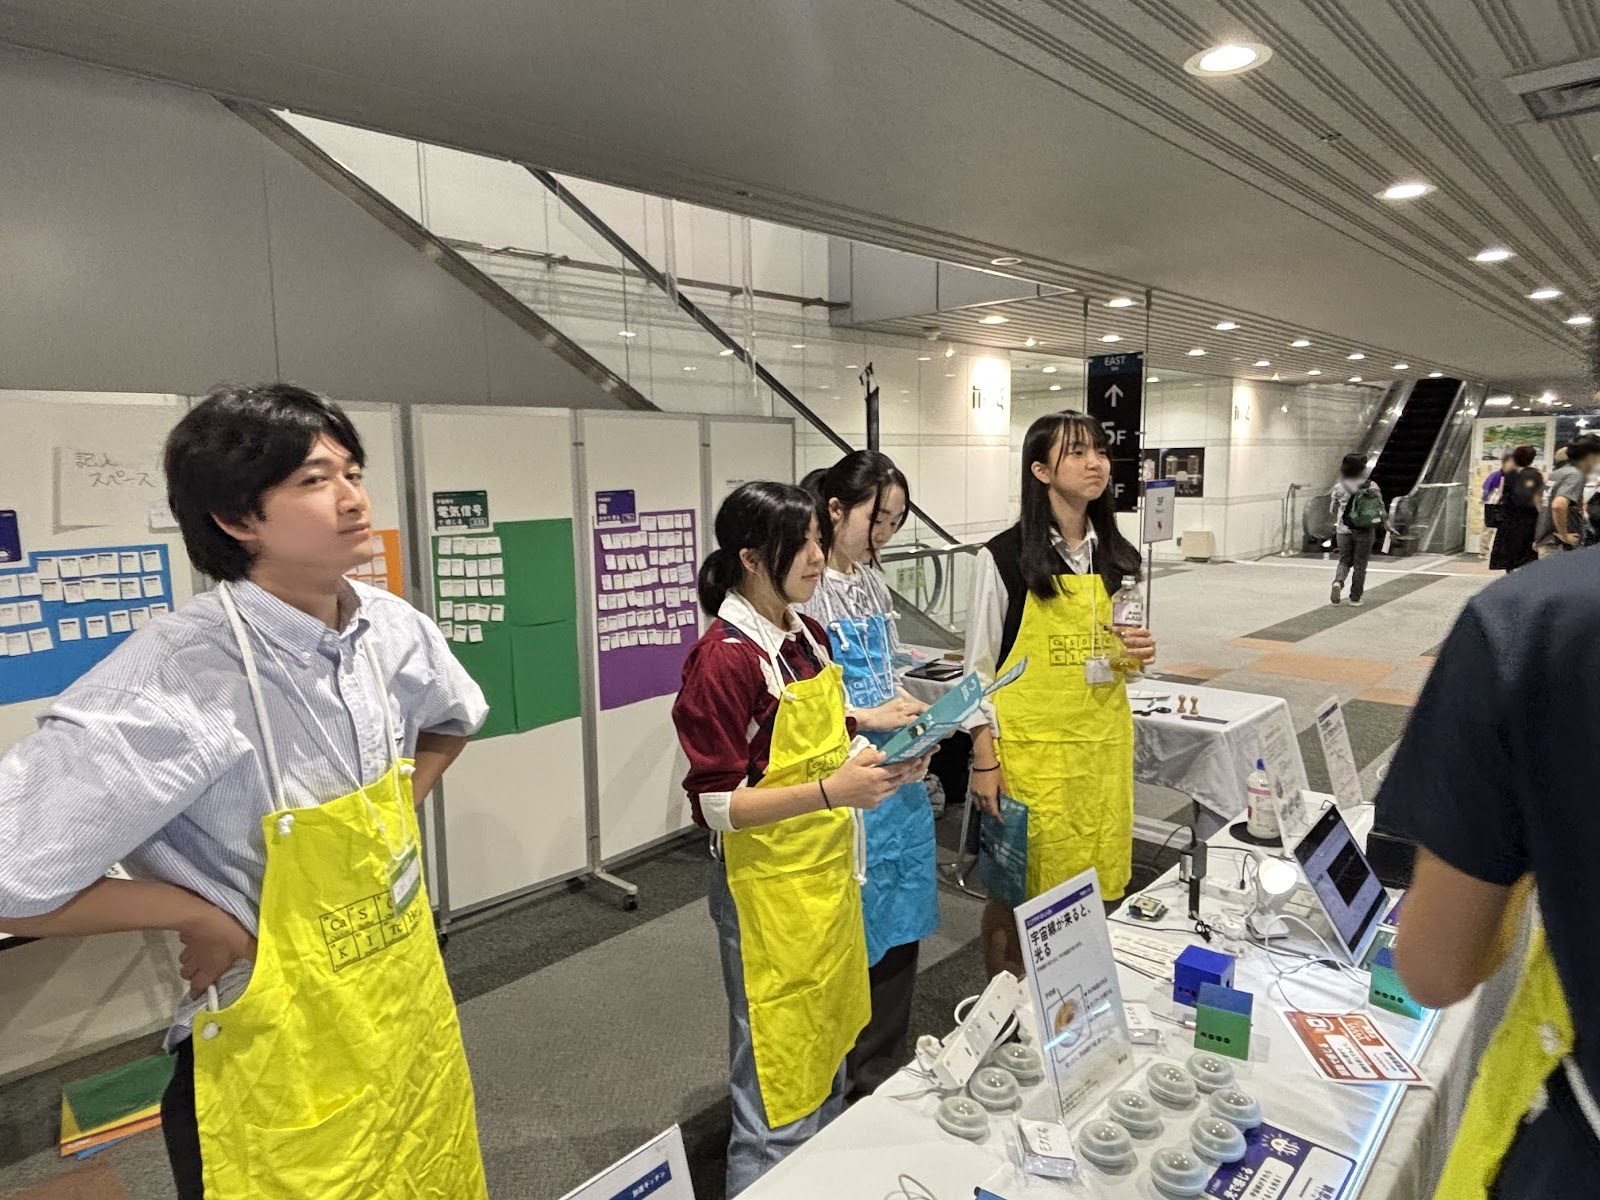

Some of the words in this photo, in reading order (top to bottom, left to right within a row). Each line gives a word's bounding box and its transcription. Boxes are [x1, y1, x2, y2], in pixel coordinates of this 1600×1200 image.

[1104, 356, 1126, 366] EAST
[1101, 421, 1127, 446] 5F
[88, 470, 157, 488] スペース
[437, 504, 483, 518] 電気信号
[330, 918, 347, 931] Ca
[359, 908, 368, 920] S
[1030, 903, 1092, 946] 宇宙線が来ると、
[338, 947, 349, 959] K
[368, 935, 374, 946] I
[1034, 942, 1052, 964] 光る
